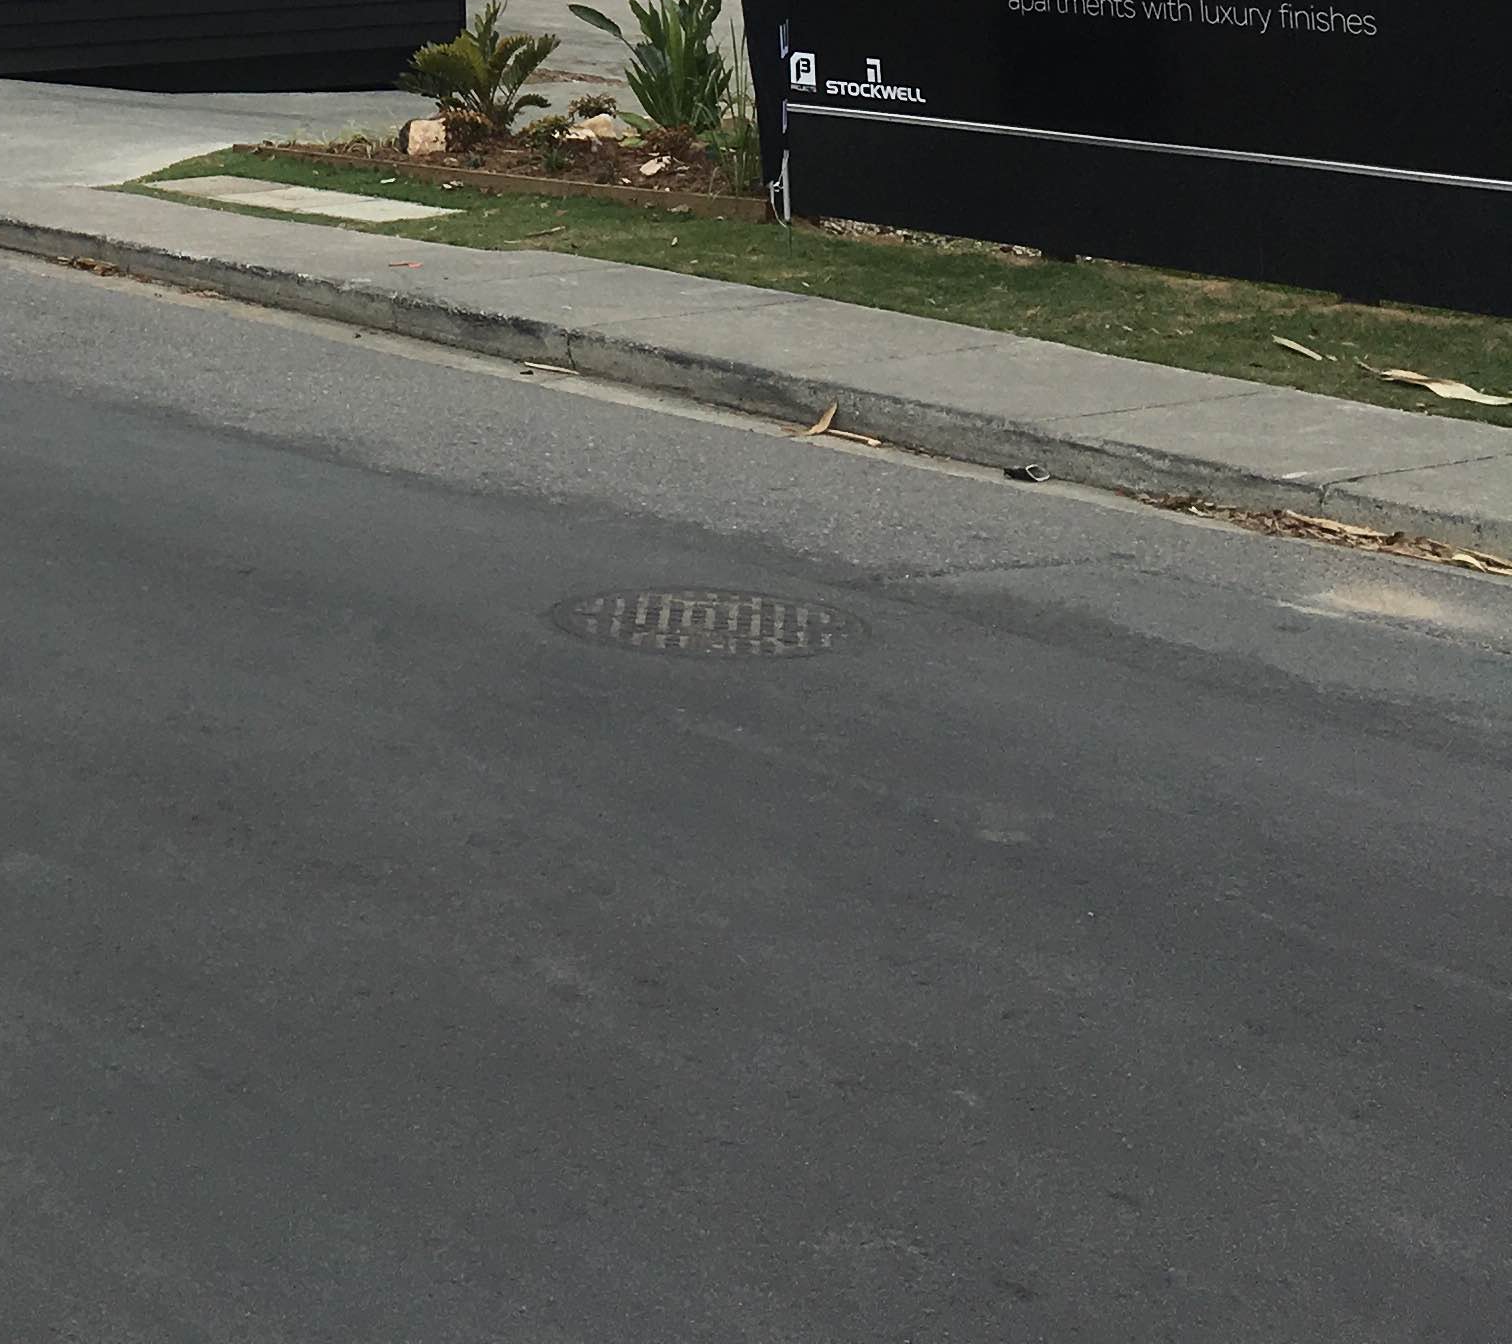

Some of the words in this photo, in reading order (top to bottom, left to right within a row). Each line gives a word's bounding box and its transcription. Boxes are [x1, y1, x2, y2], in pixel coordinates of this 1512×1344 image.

[1199, 0, 1272, 35] luxury
[1279, 3, 1377, 36] finishes
[825, 80, 927, 103] STOCKWELL
